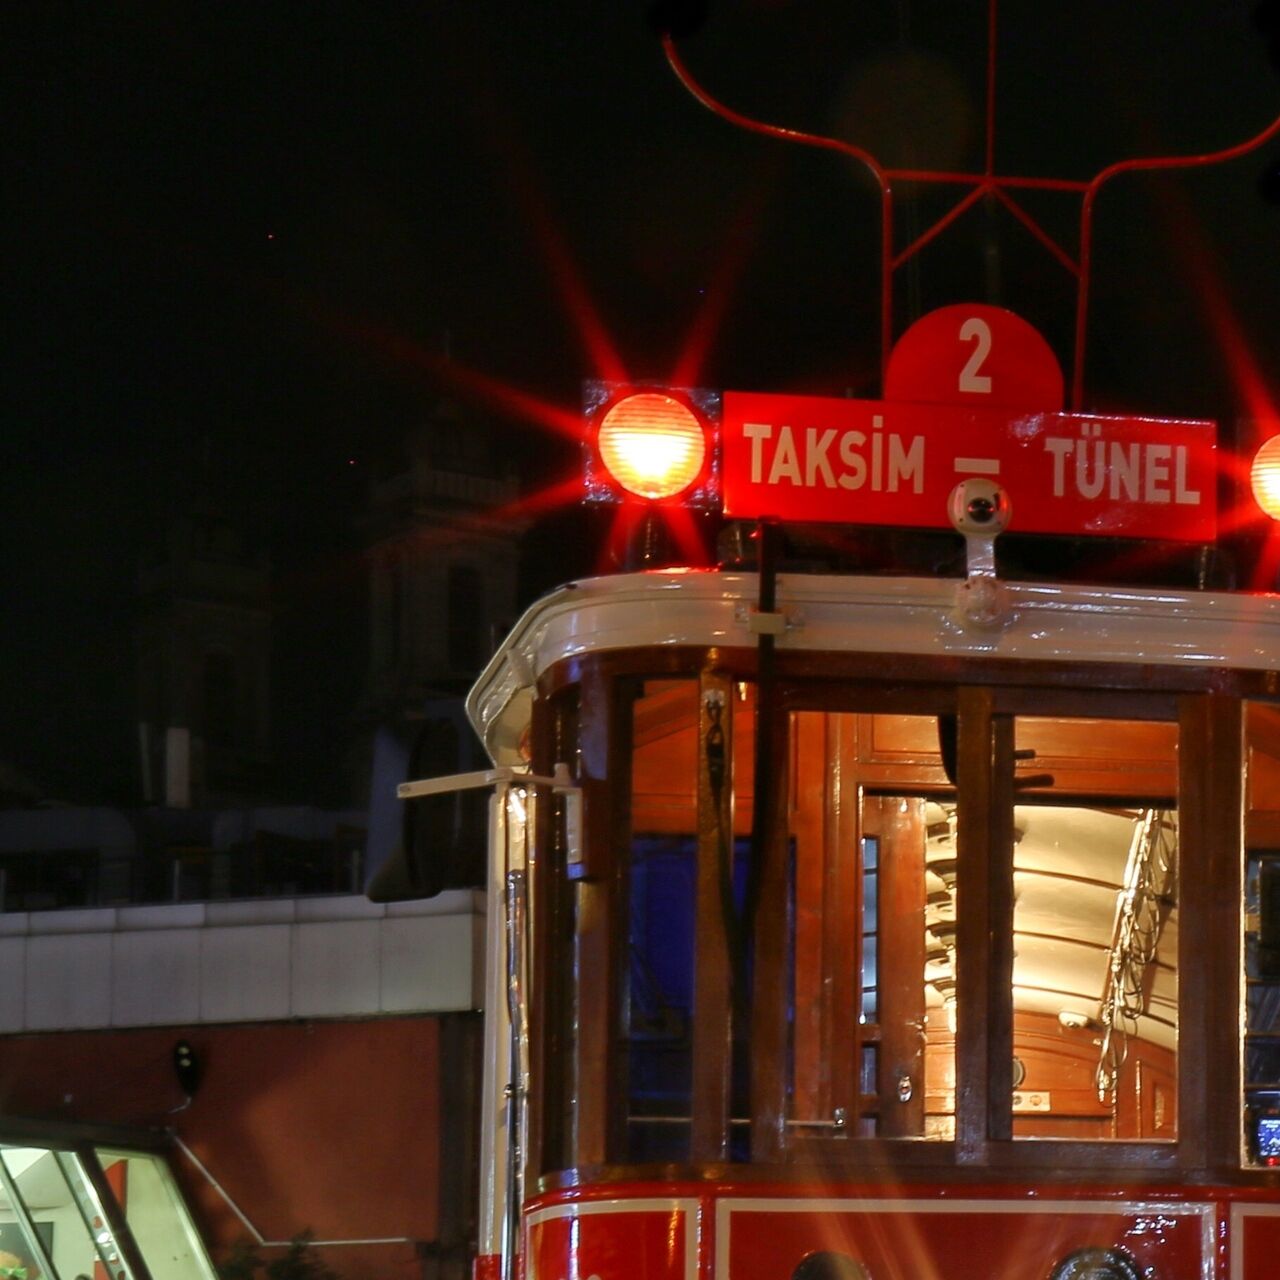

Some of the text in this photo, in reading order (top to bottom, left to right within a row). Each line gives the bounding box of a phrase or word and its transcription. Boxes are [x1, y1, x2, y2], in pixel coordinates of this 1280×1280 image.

[958, 317, 993, 394] 2
[743, 415, 925, 494] TAKSİM
[1044, 422, 1201, 505] TÜNEL
